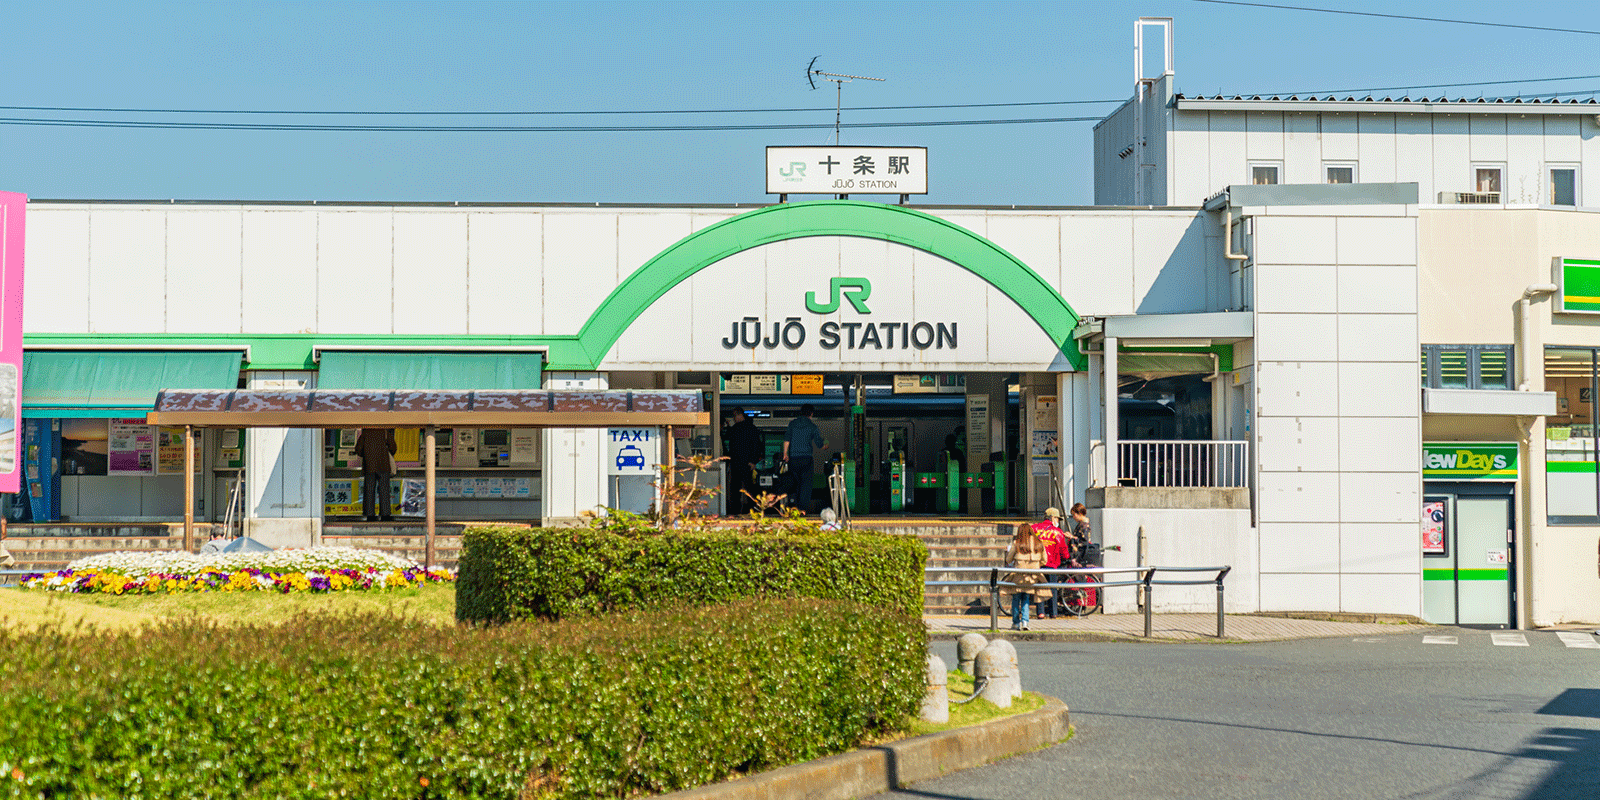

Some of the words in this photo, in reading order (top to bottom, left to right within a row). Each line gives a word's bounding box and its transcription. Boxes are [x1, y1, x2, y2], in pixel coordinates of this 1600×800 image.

[779, 162, 807, 177] JR
[818, 155, 910, 175] 十条駅
[859, 180, 897, 189] STATION
[805, 277, 872, 314] JR
[722, 316, 806, 350] JŪJŌ
[819, 321, 958, 350] STATION
[610, 430, 649, 442] TAXI
